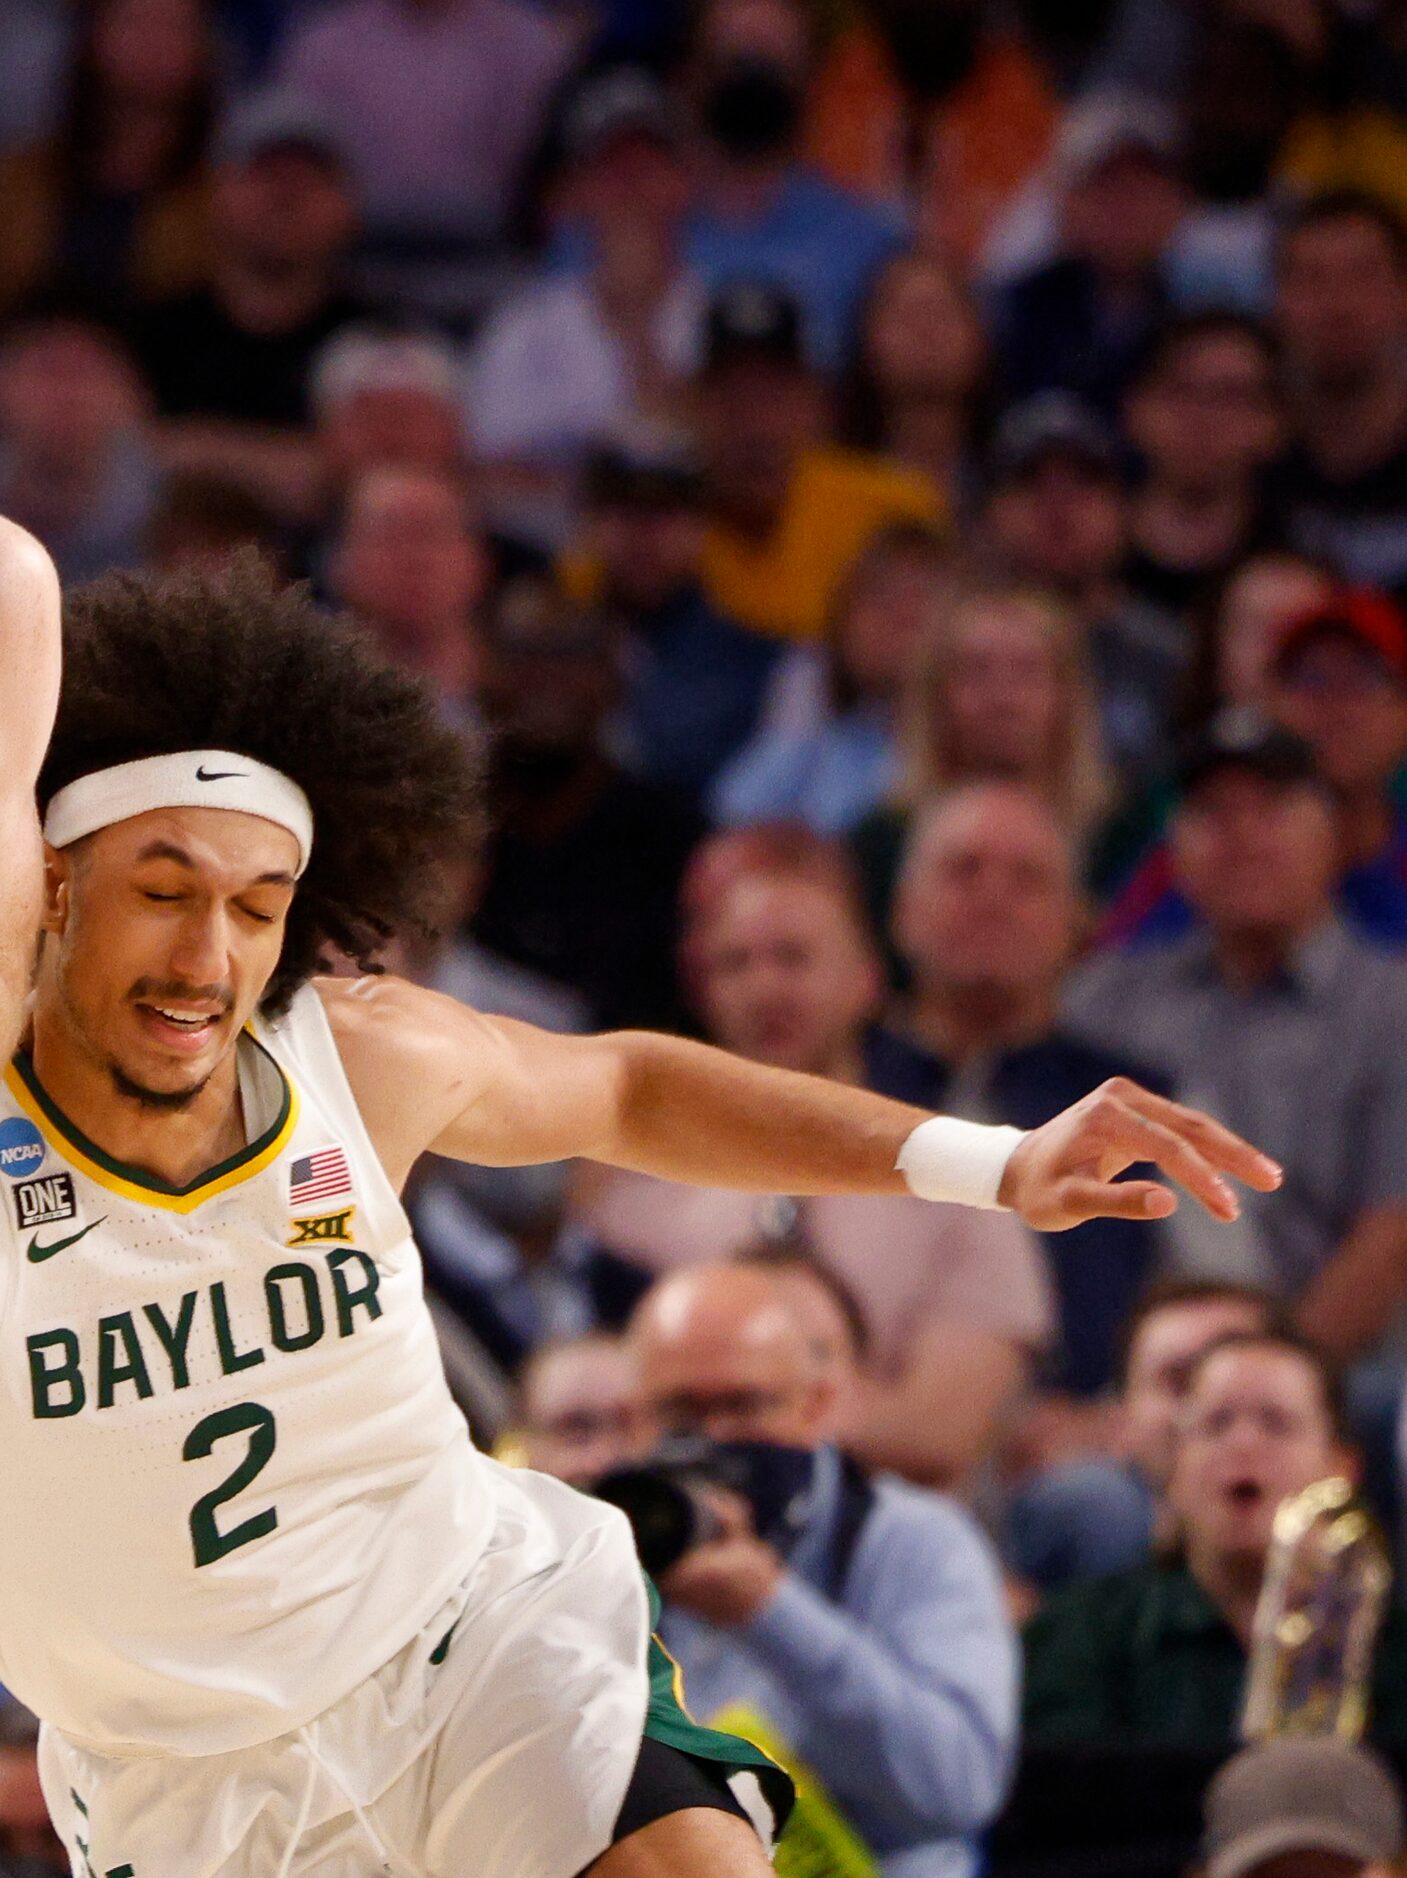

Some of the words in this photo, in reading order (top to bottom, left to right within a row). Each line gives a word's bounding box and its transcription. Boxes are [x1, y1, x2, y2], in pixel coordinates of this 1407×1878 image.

[0, 1143, 44, 1165] NCAA
[19, 1177, 72, 1218] ONE
[288, 1210, 353, 1244] XII
[26, 1247, 383, 1419] BAYLOR
[182, 1402, 278, 1568] 2
